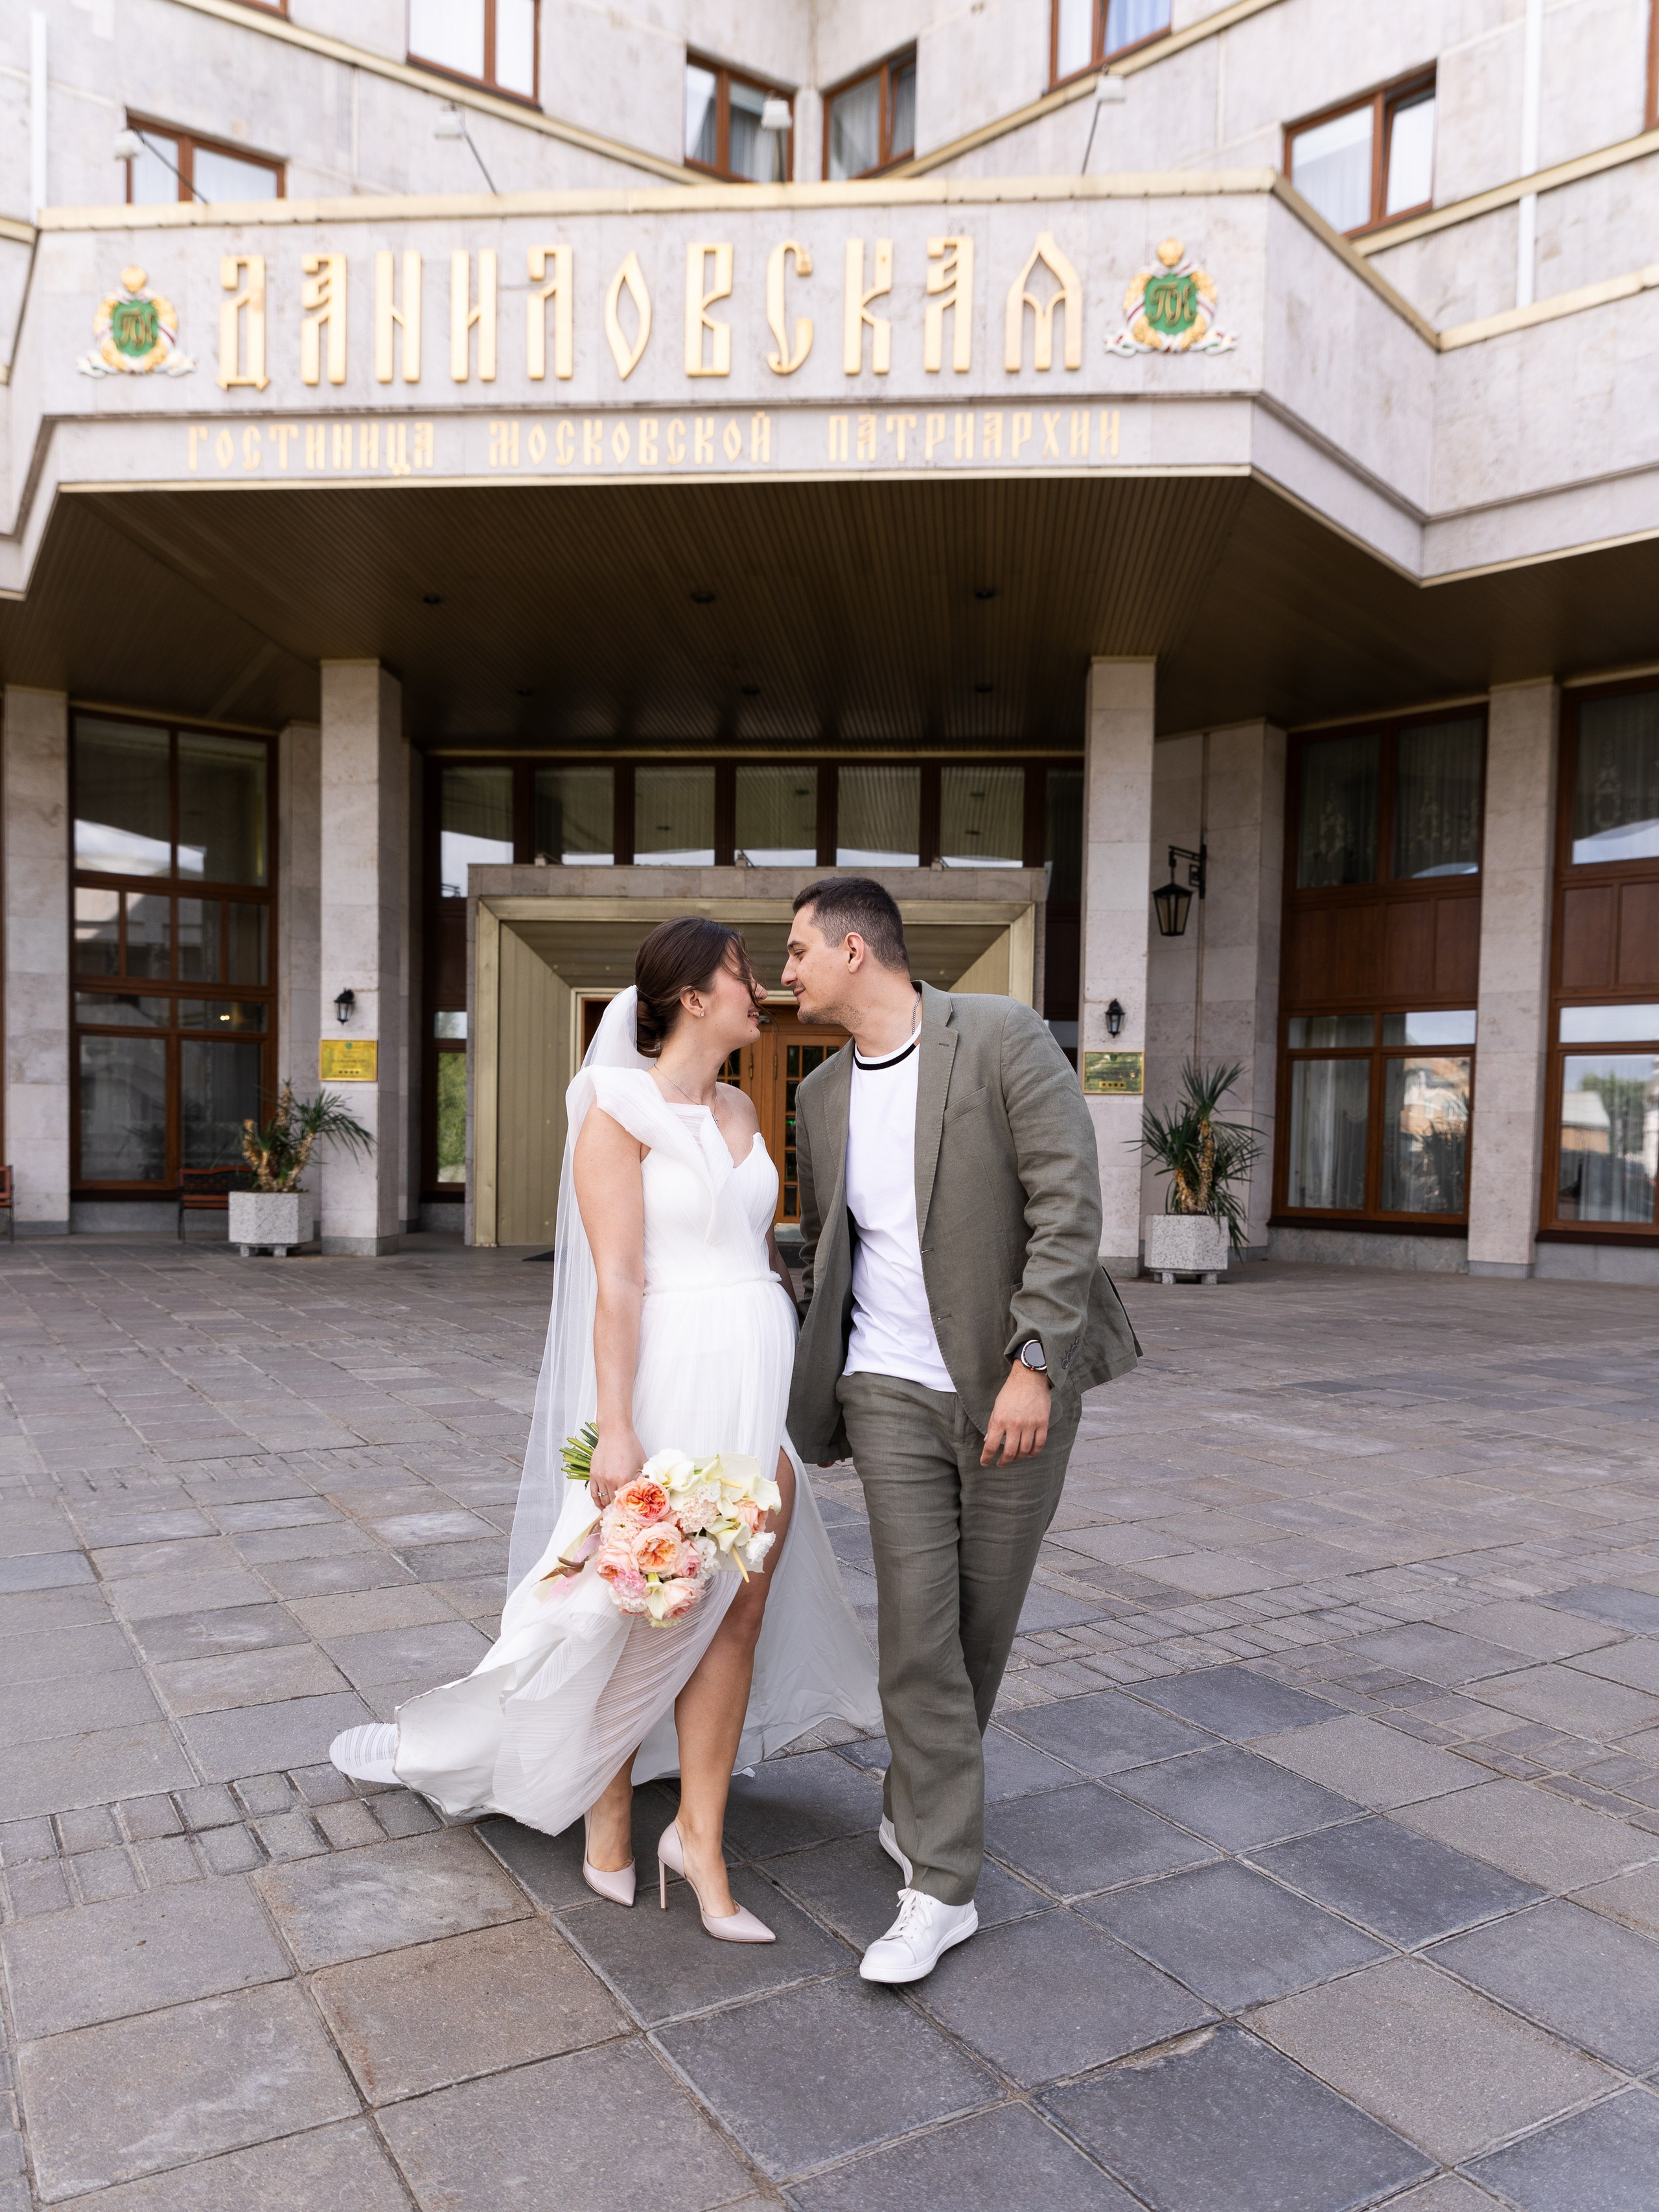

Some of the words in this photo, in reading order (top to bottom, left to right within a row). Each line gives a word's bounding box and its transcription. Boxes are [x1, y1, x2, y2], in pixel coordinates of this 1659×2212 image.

[188, 421, 435, 477] ГОСТИНИЦА
[488, 411, 771, 469] МОСКОВСКОЙ
[828, 410, 1120, 463] ПАТРИАРХИИ
